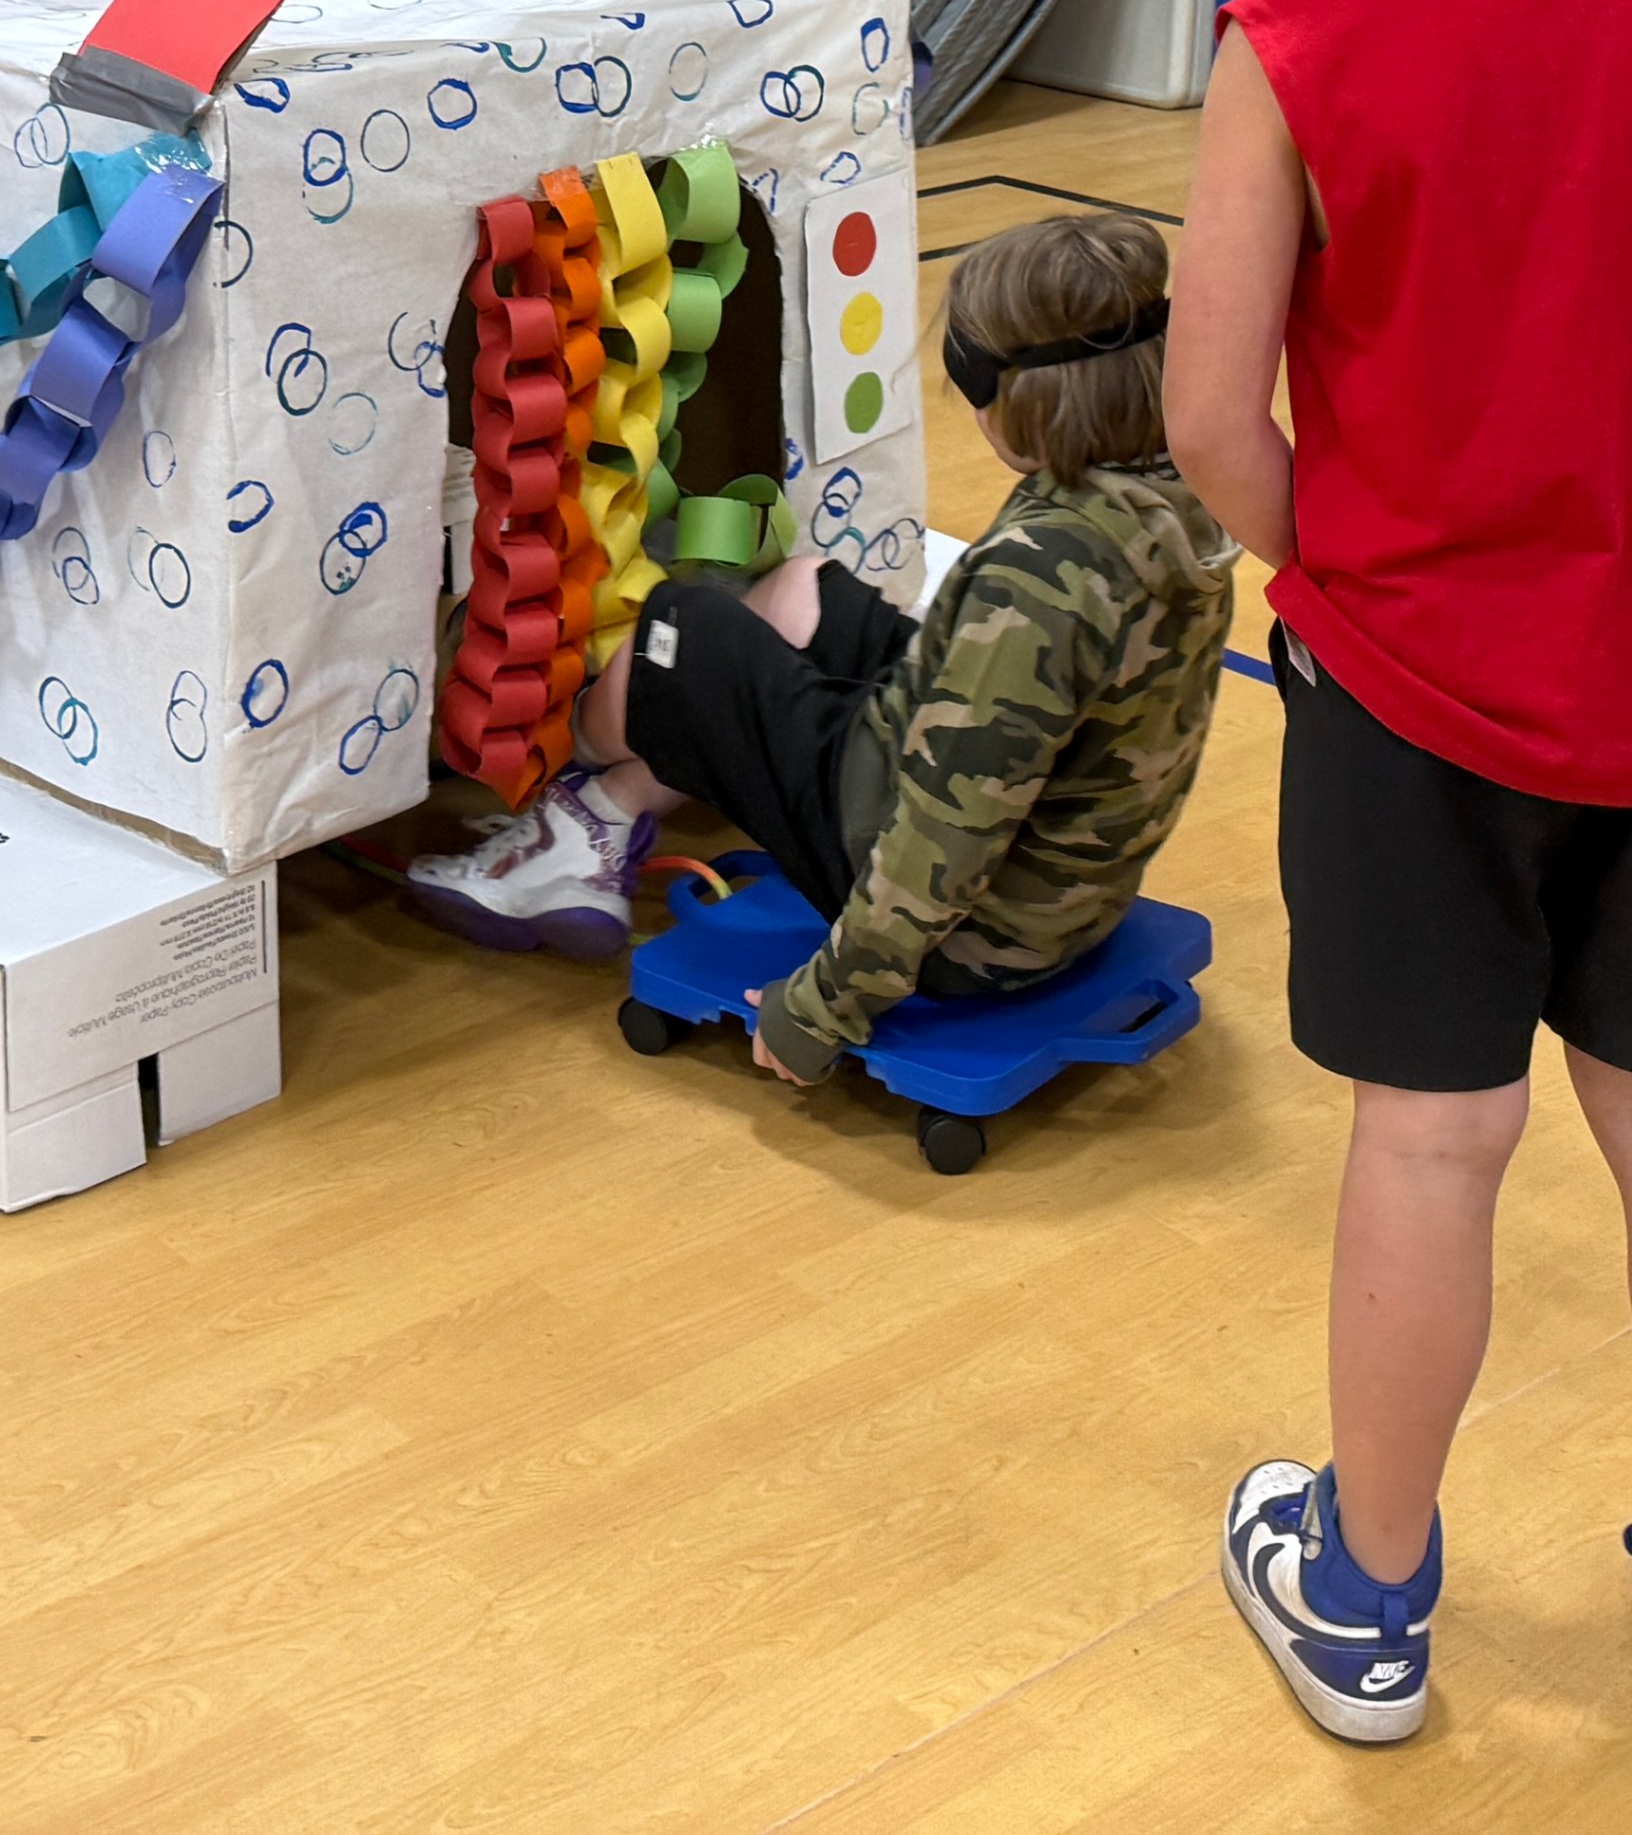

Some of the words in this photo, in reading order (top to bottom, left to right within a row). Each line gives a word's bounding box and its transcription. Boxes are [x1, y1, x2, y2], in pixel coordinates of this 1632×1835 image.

[199, 967, 257, 998] Multipurpose
[107, 1000, 141, 1022] Usage
[172, 994, 197, 1010] Copy
[140, 1006, 169, 1024] Paper
[1368, 1660, 1410, 1680] NIKE
